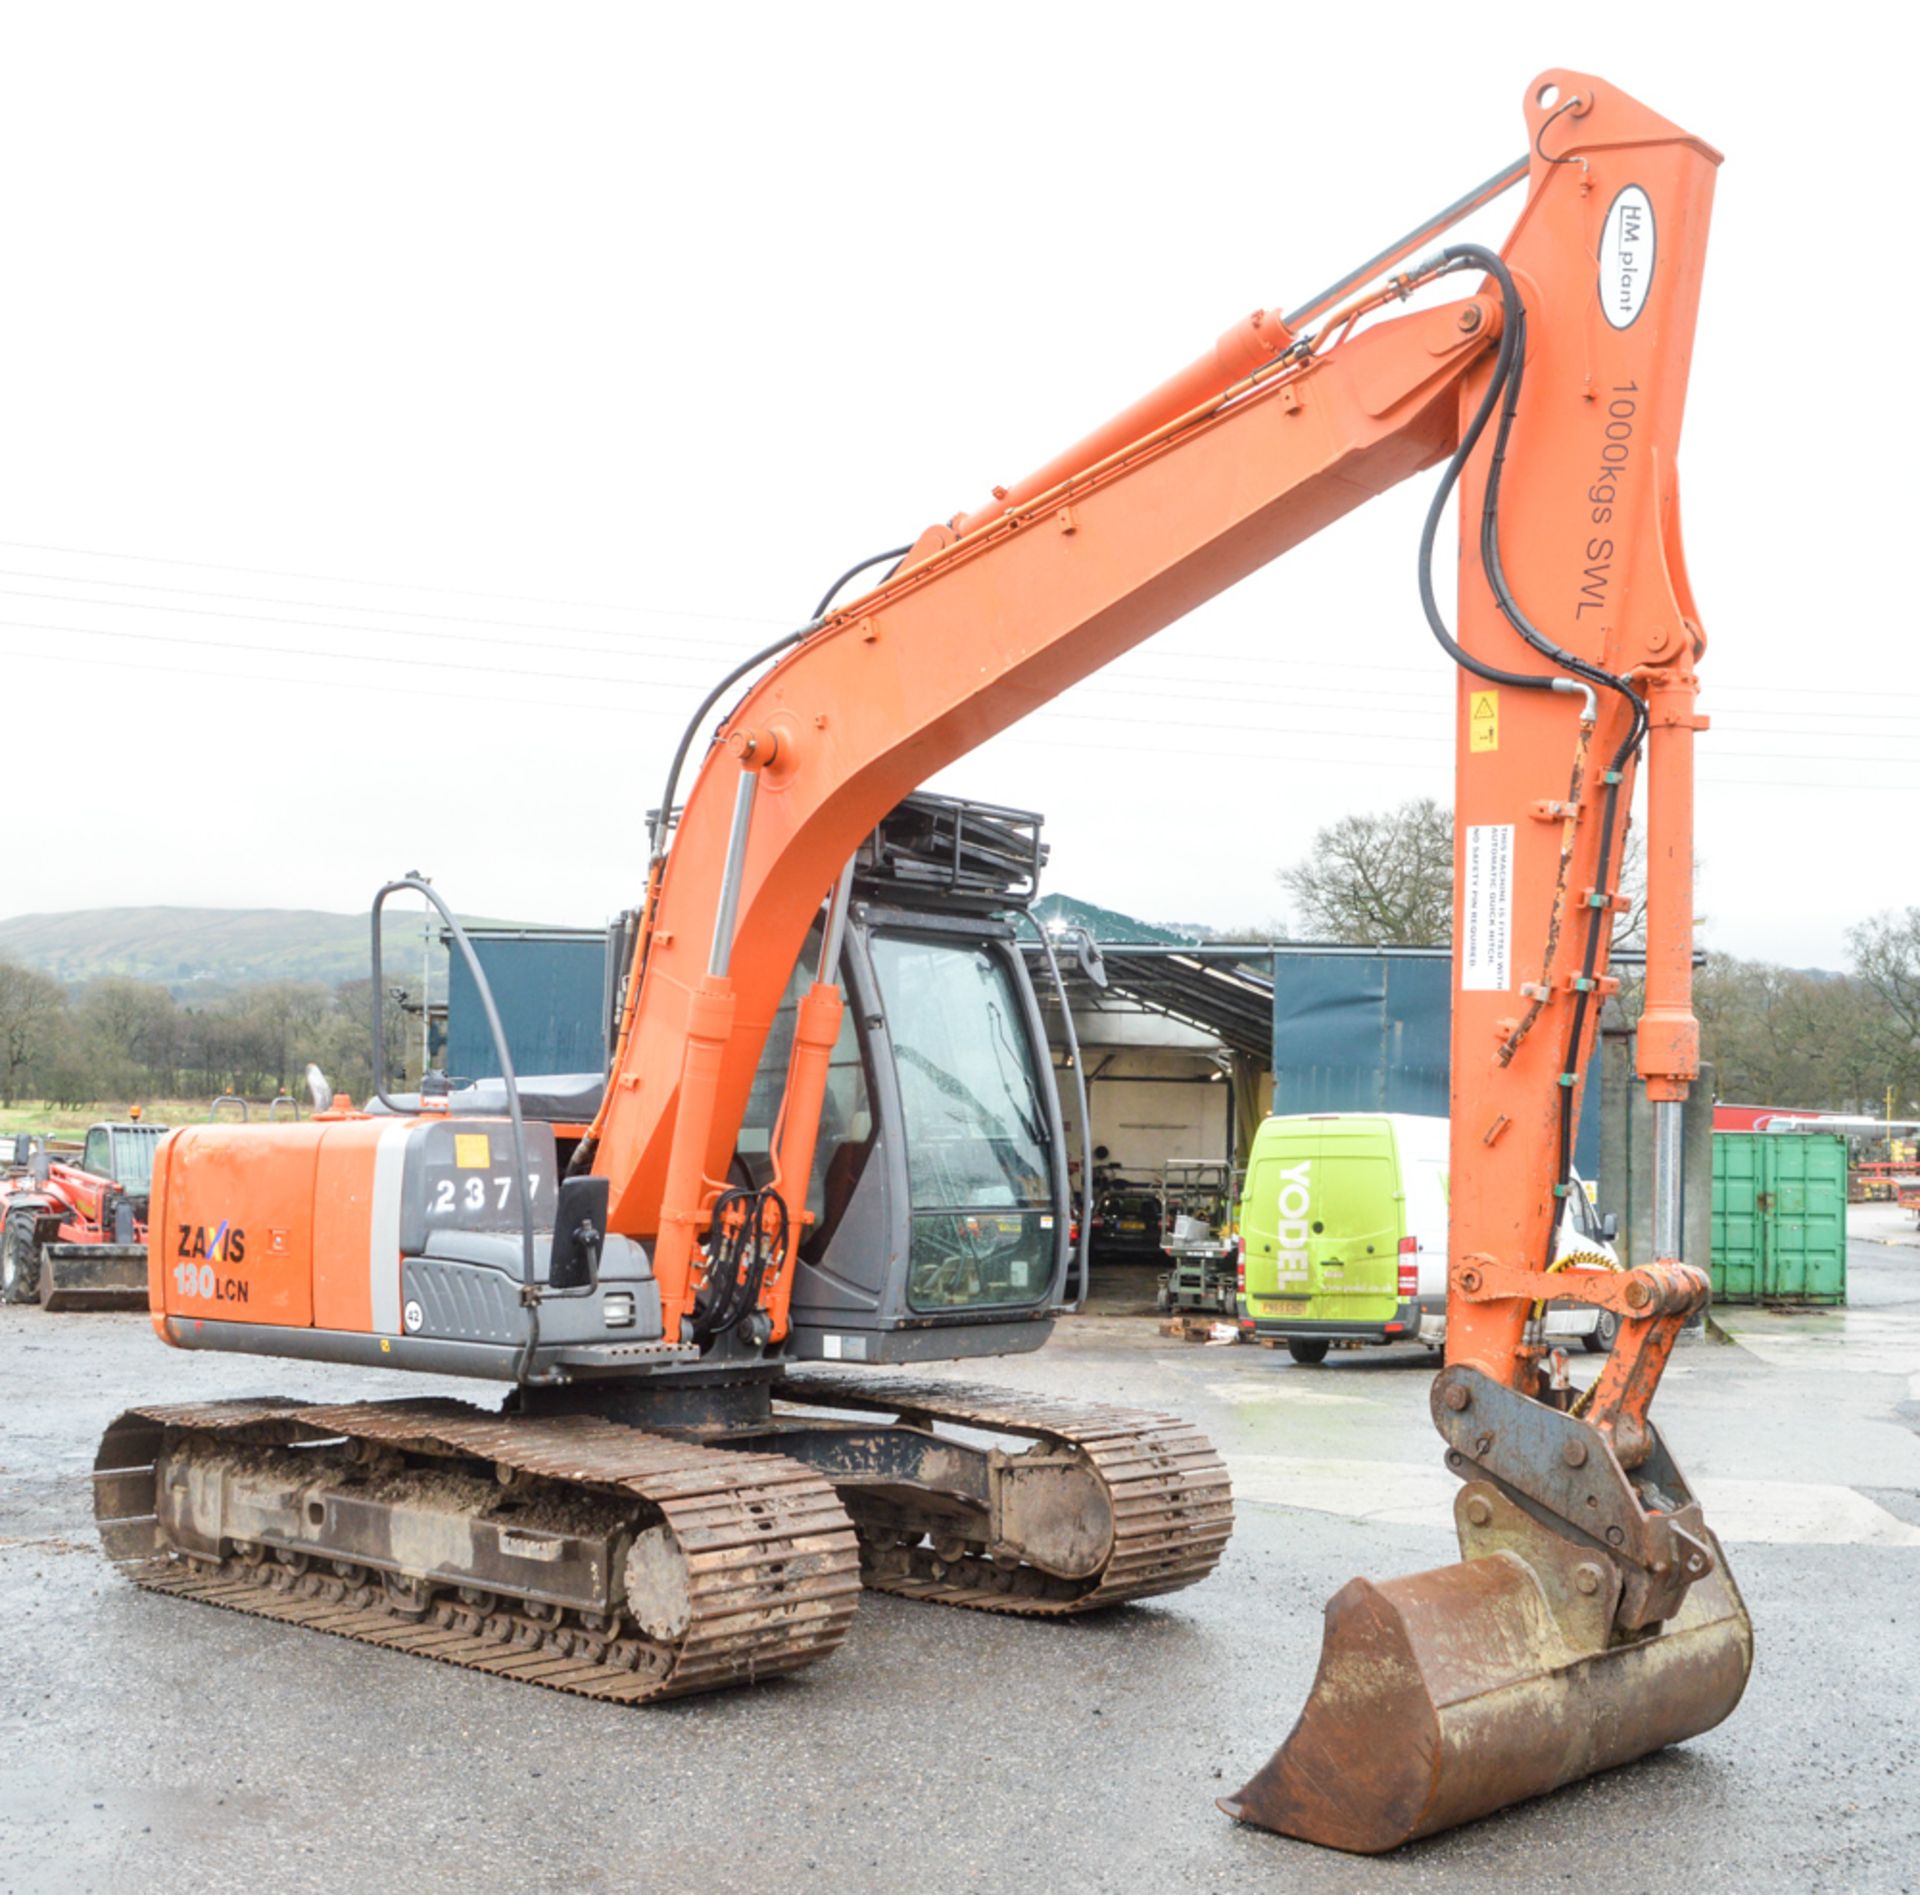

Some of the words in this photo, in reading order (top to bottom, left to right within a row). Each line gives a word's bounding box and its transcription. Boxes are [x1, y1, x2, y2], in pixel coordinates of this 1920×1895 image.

[1620, 205, 1641, 242] HM
[1619, 251, 1638, 312] plant
[1588, 380, 1638, 524] 1000kgs
[1576, 538, 1613, 620] SWL
[1473, 828, 1480, 844] NO
[1500, 827, 1508, 851] THIS
[1471, 846, 1479, 887] SAFETY
[1489, 827, 1498, 889] AUTOMATIC
[1499, 854, 1507, 903] MACHINE
[1488, 892, 1497, 926] QUICK
[1498, 907, 1505, 918] IS
[1487, 930, 1496, 967] HITCH.
[1497, 921, 1505, 959] FITTED
[1496, 962, 1504, 990] WITH
[178, 1219, 245, 1263] ZAXIS
[1278, 1159, 1312, 1291] YODEL
